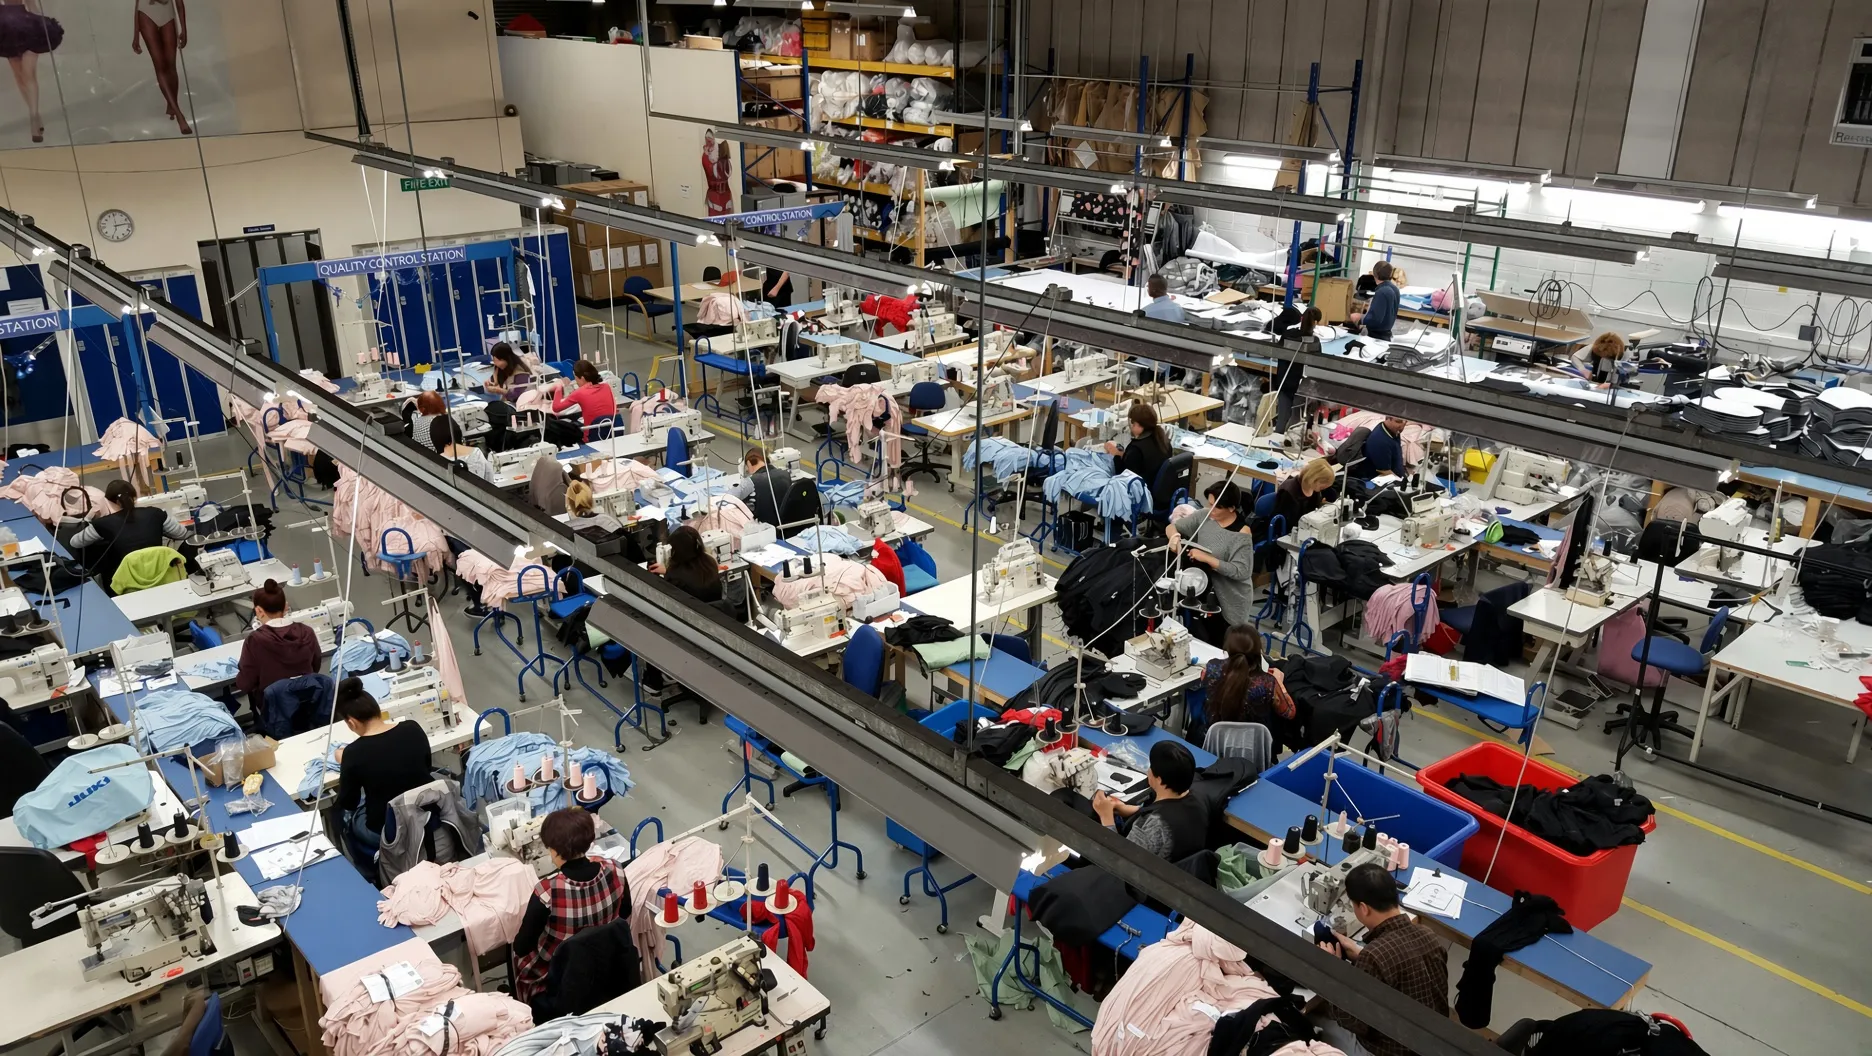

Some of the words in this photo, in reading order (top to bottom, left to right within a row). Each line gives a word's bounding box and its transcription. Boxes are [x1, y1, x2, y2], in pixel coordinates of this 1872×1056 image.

[428, 178, 448, 188] EXIT
[745, 212, 782, 225] CONTROL
[782, 208, 813, 221] STATION
[320, 260, 367, 276] QUALITY
[368, 254, 419, 270] CONTROL
[421, 249, 464, 263] STATION
[68, 776, 111, 807] JUKI
